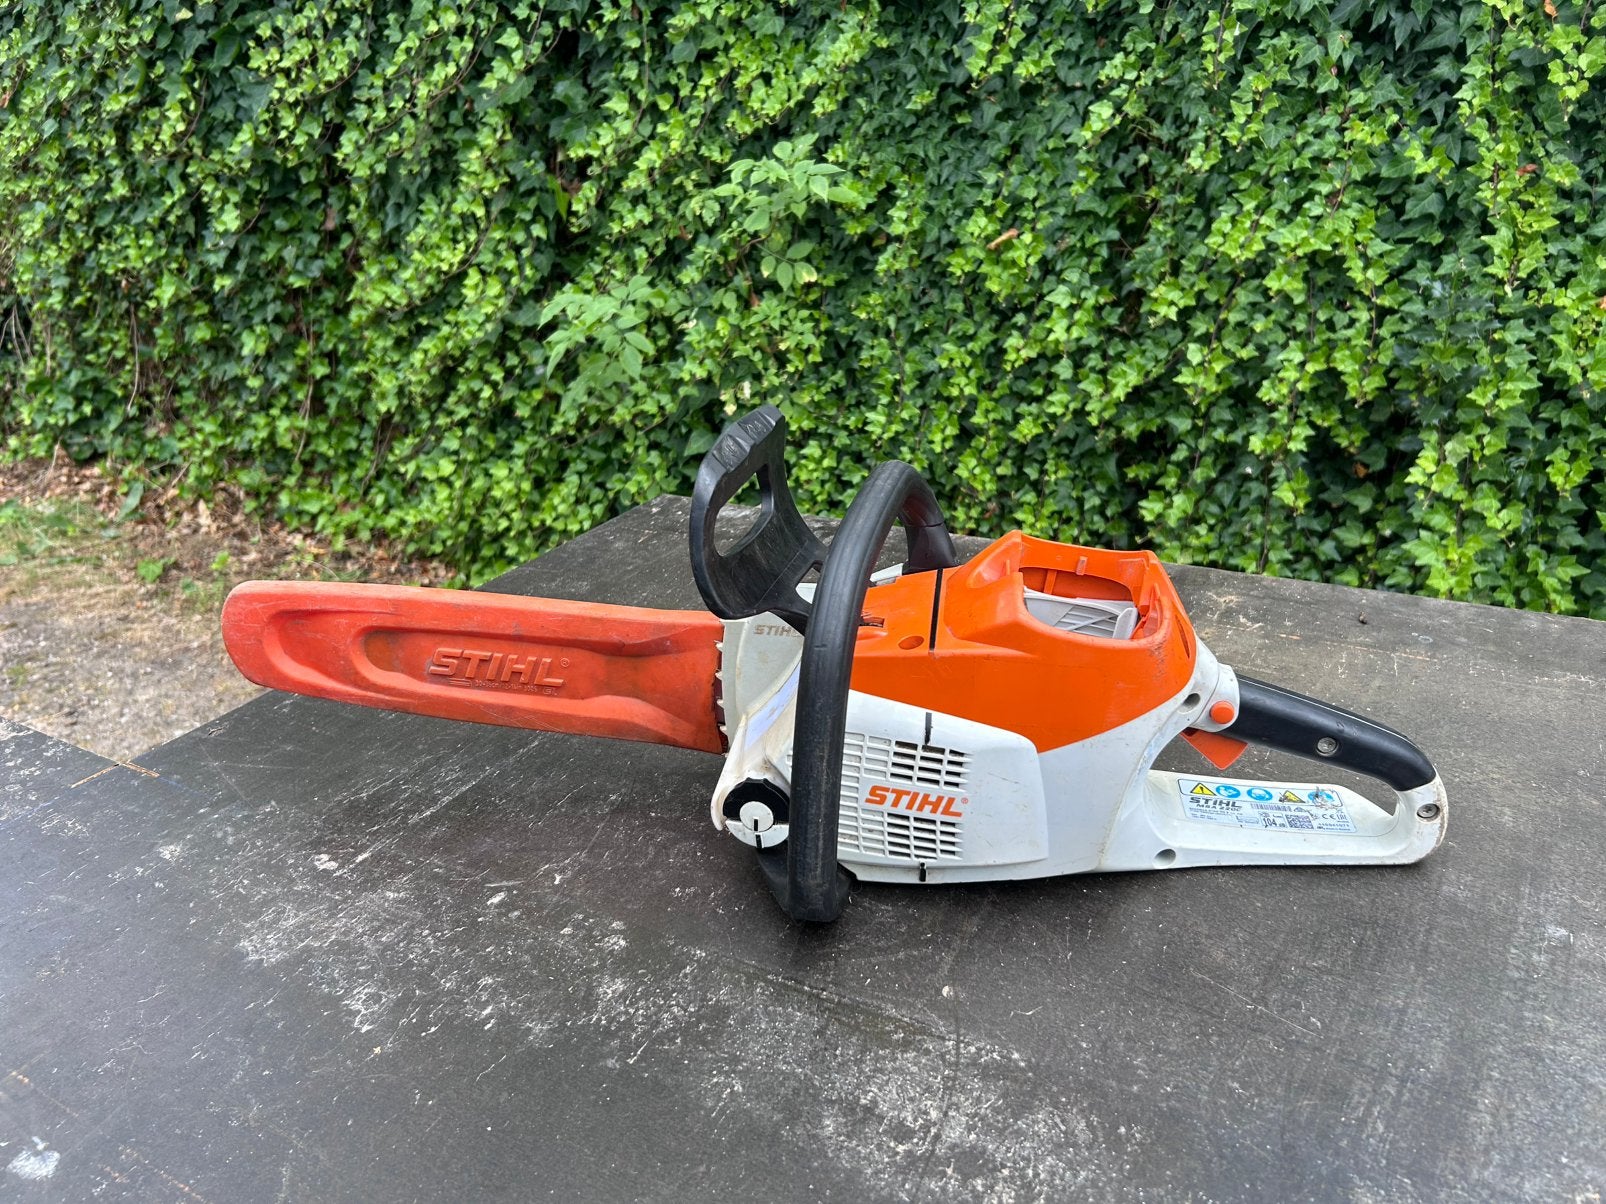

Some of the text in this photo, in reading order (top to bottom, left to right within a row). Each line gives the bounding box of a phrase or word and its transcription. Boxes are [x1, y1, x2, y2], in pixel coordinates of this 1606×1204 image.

[428, 647, 564, 687] STIHL
[864, 785, 963, 818] STIHL
[1189, 796, 1242, 809] STIHL
[1262, 817, 1277, 828] 104
